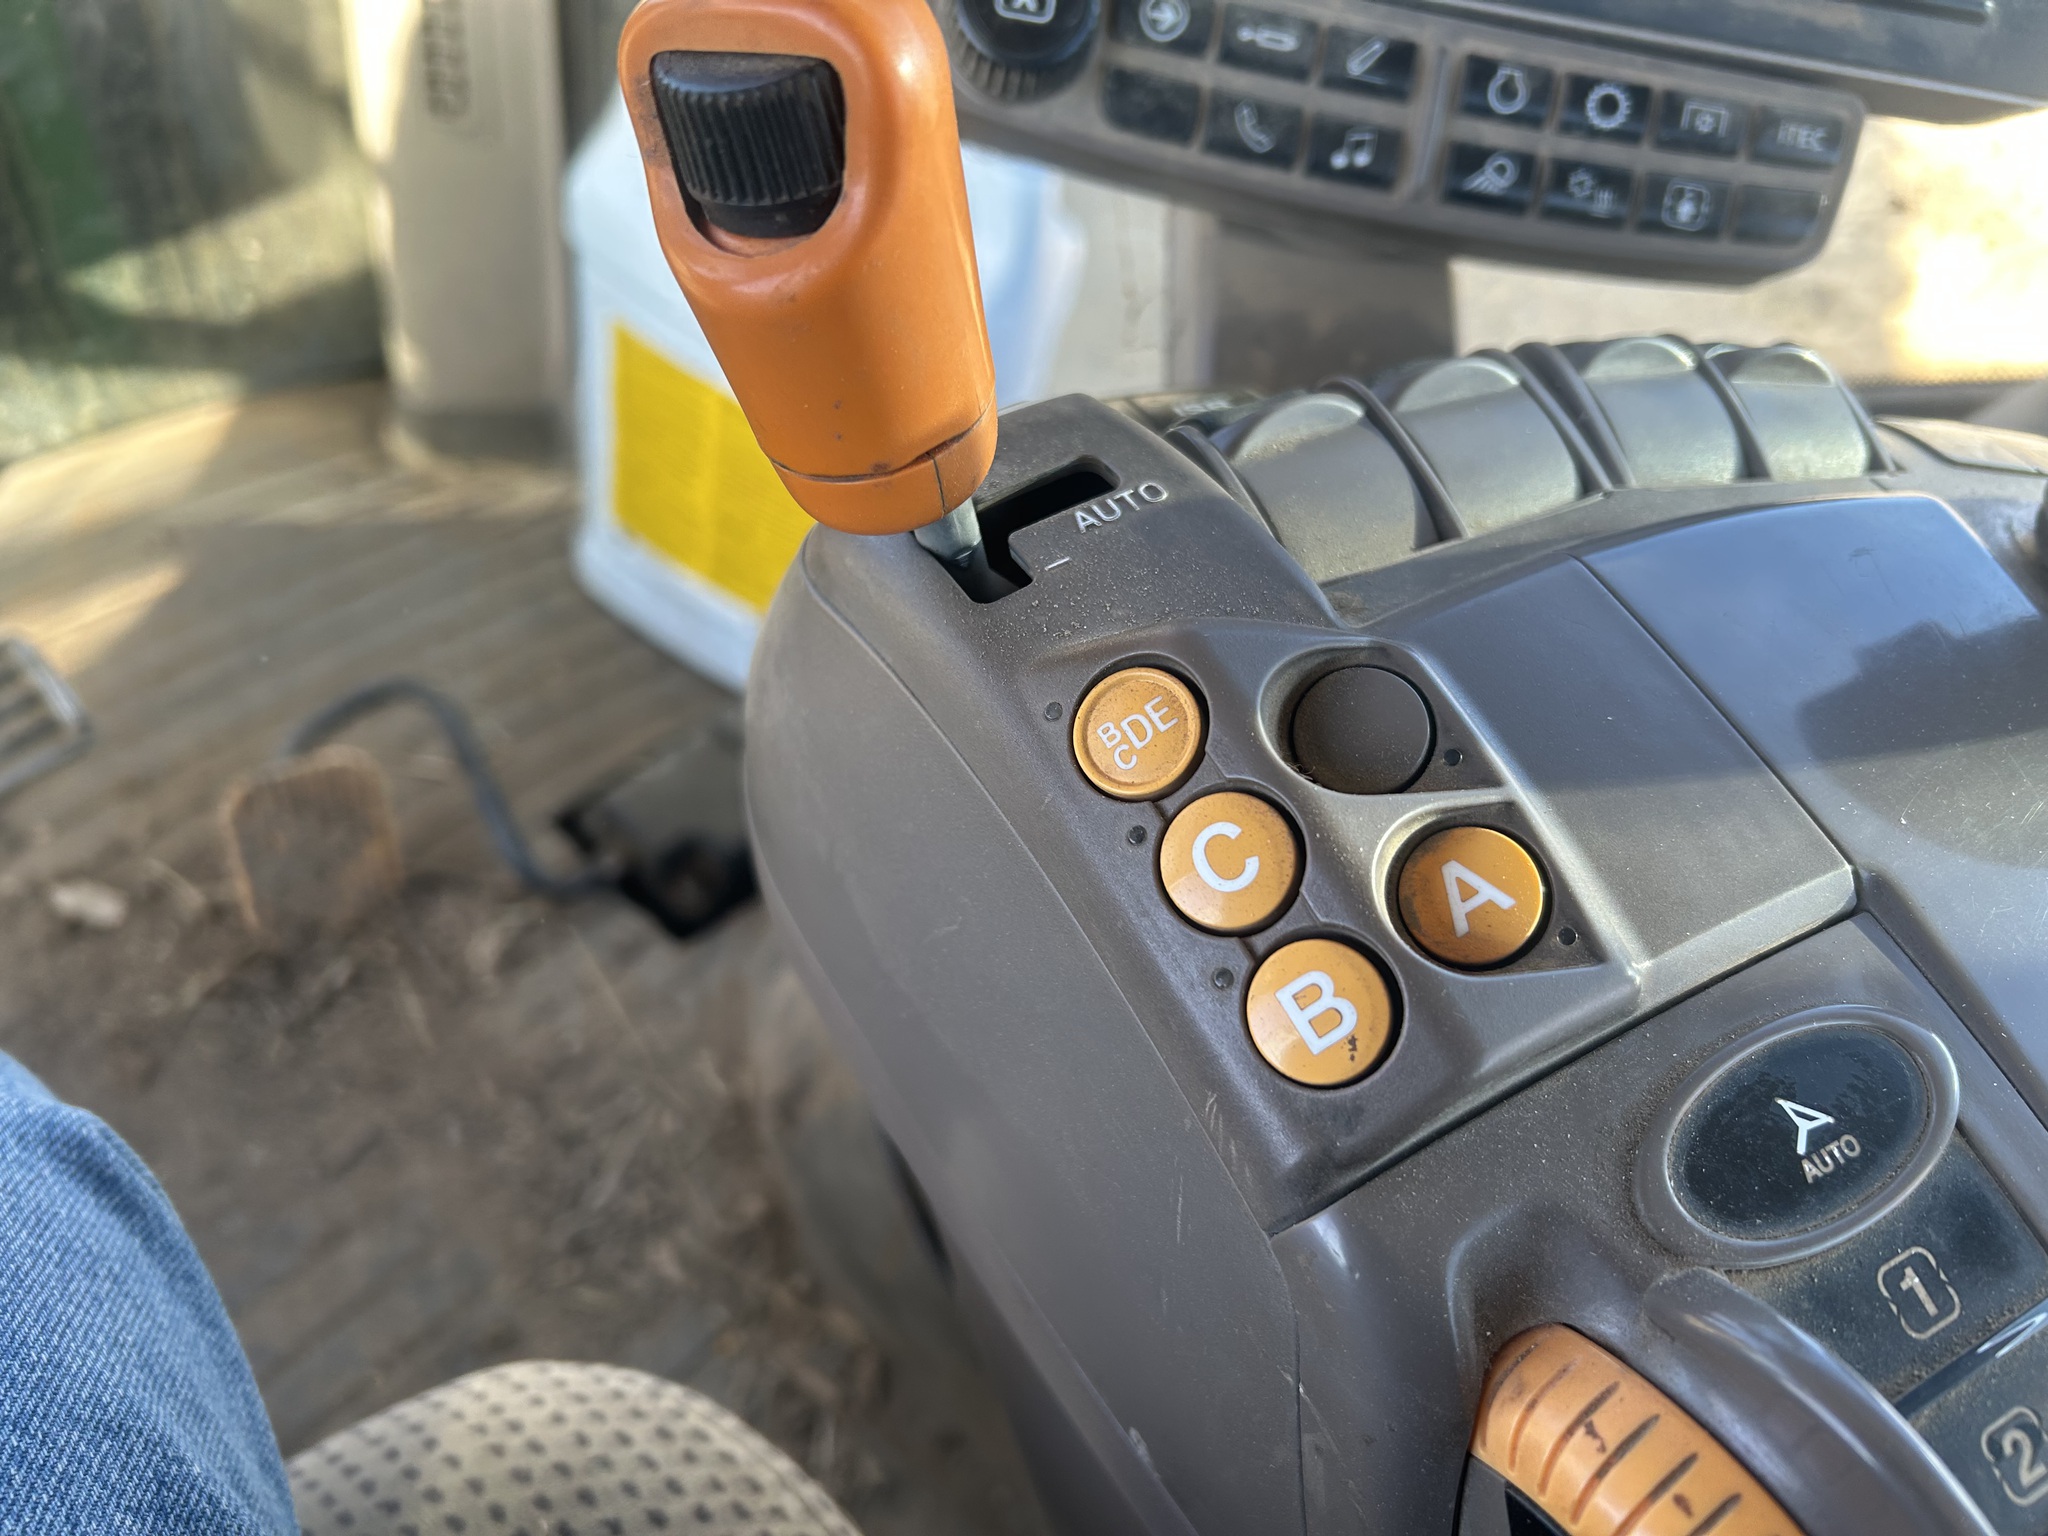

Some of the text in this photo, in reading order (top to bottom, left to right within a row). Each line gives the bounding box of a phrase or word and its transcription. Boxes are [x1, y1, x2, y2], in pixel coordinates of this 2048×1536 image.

[1074, 482, 1169, 534] AUTO
[1192, 821, 1259, 893] C
[1441, 860, 1515, 938] A
[1275, 970, 1358, 1055] B
[1800, 1133, 1862, 1184] AUTO
[1900, 1266, 1938, 1317] 1
[2000, 1428, 2046, 1488] 2
